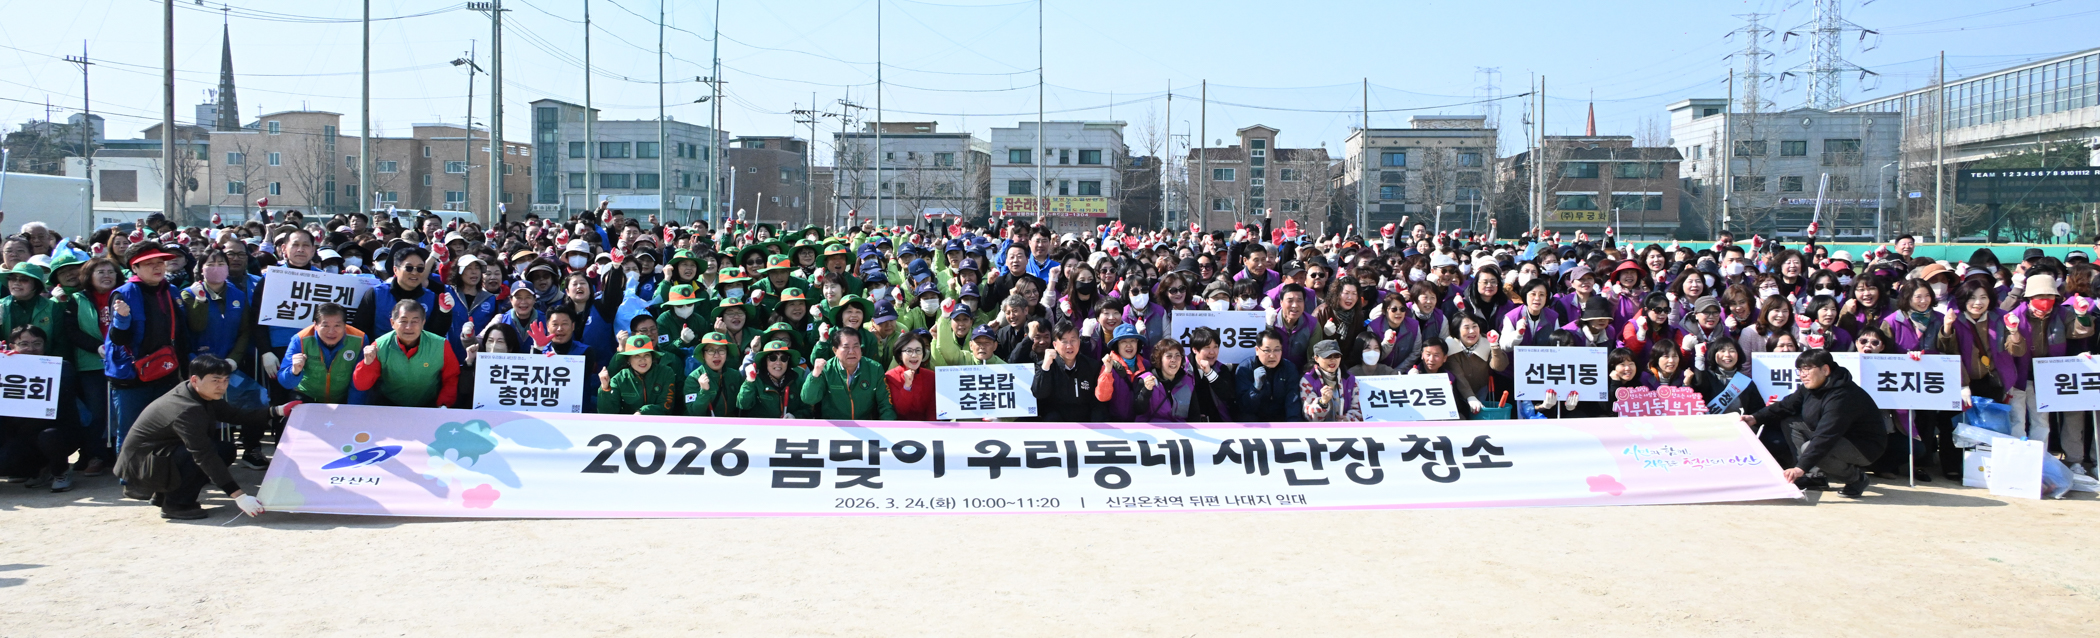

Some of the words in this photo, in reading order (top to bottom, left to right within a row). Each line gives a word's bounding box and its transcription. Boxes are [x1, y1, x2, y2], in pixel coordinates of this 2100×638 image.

[290, 280, 356, 306] 바르게
[276, 300, 358, 325] 살기
[1180, 327, 1258, 348] 선3동
[490, 364, 570, 386] 한국자유
[959, 373, 1015, 391] 로보캅
[1525, 363, 1598, 385] 선부1동
[1877, 370, 1945, 394] 초지동
[2054, 373, 2100, 395] 원곡
[0, 374, 53, 401] 을회
[498, 386, 560, 407] 총연맹
[1368, 388, 1446, 408] 선부2동
[960, 392, 1016, 410] 순찰대
[580, 434, 749, 476] 2026
[769, 438, 945, 489] 봄맞이
[967, 438, 1196, 490] 우리동네
[1212, 437, 1385, 486] 새단장
[1399, 434, 1513, 484] 청소
[1728, 454, 1762, 466] 안산
[330, 476, 380, 486] 안산시
[835, 498, 880, 510] 2026.
[886, 498, 900, 510] 3.
[905, 497, 956, 510] 24.(화)
[964, 498, 1060, 509] 10:00~11:20
[1106, 496, 1184, 508] 신길온천역
[1190, 496, 1220, 508] 뒤편
[1226, 495, 1272, 506] 나대지
[1276, 494, 1308, 506] 일대
